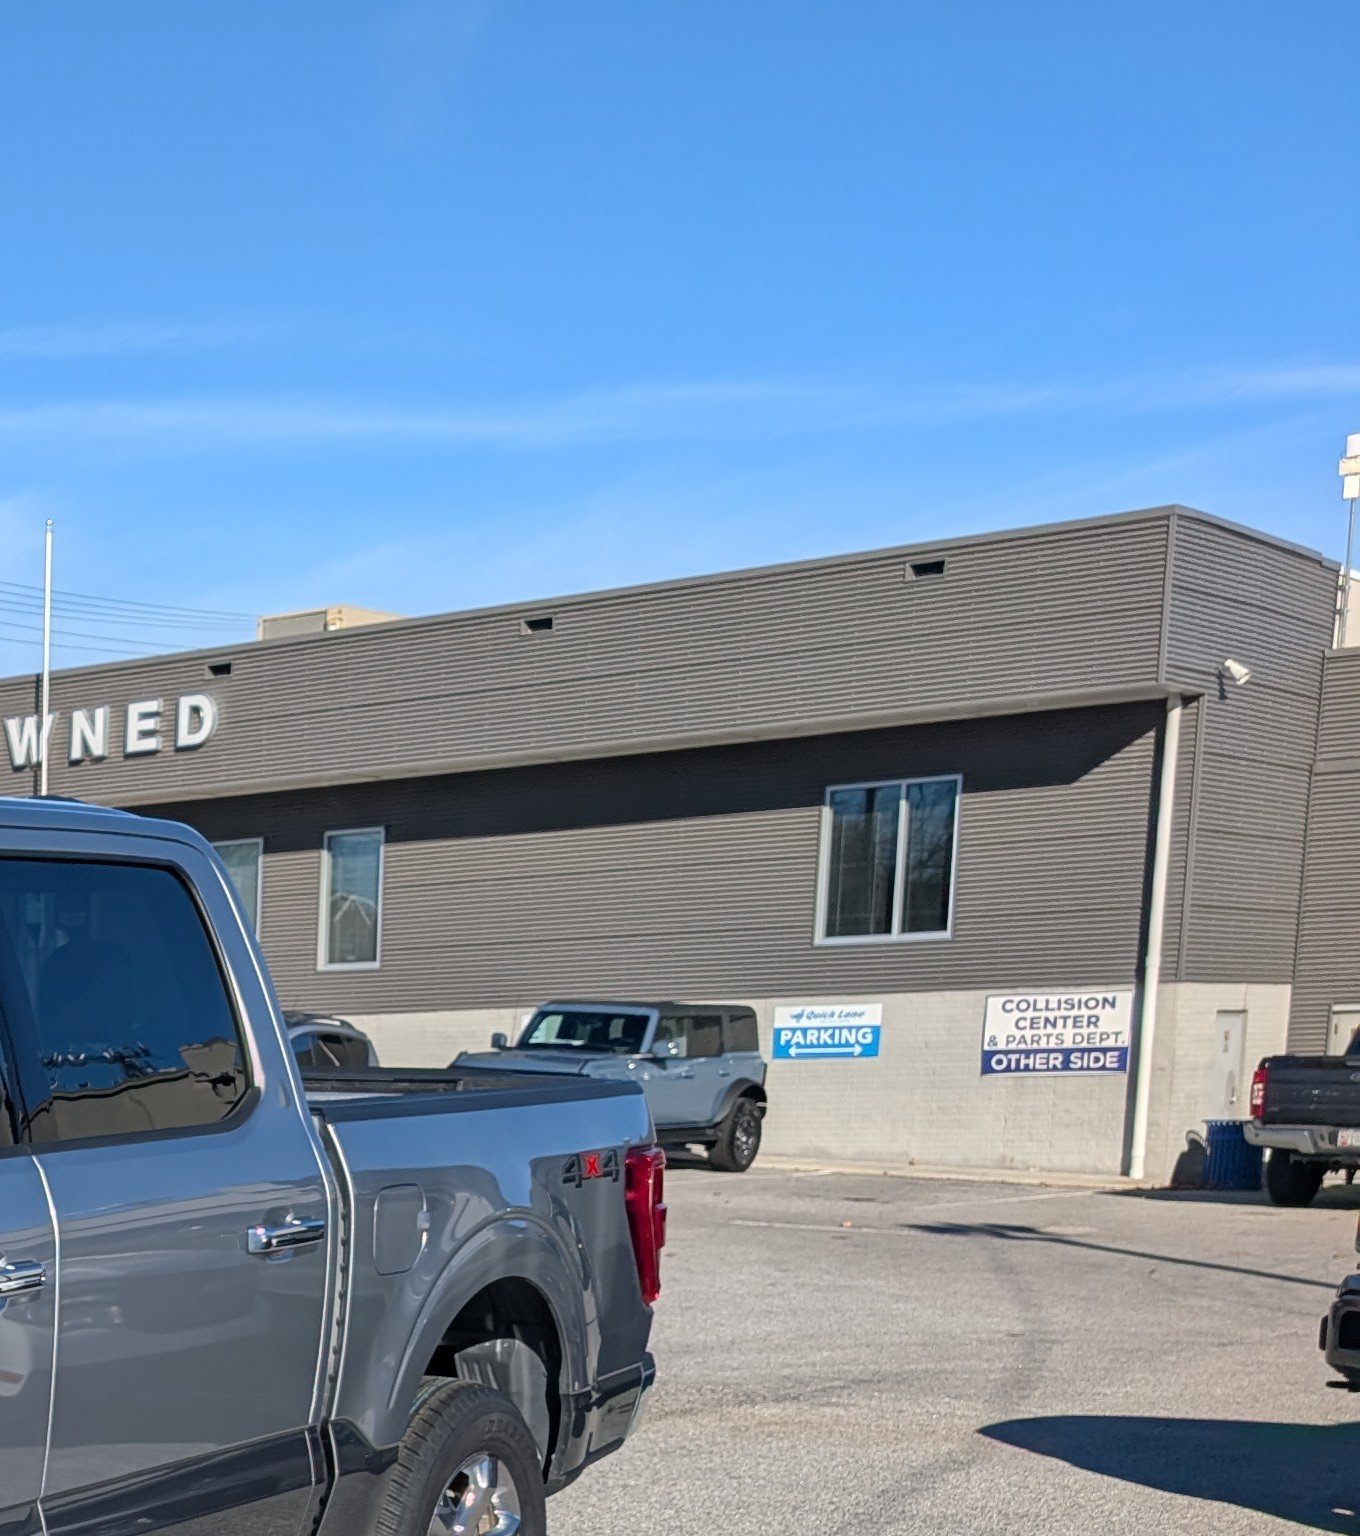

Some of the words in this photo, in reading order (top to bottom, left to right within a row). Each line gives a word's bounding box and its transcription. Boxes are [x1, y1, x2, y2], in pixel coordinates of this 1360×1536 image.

[1001, 995, 1117, 1013] COLLISION
[1014, 1014, 1100, 1031] CENTER
[779, 1027, 873, 1046] PARKING
[987, 1035, 998, 1047] &
[1005, 1032, 1065, 1047] PARTS
[1072, 1031, 1126, 1045] DEPT.
[990, 1051, 1063, 1071] OTHER
[1069, 1050, 1120, 1069] SIDE
